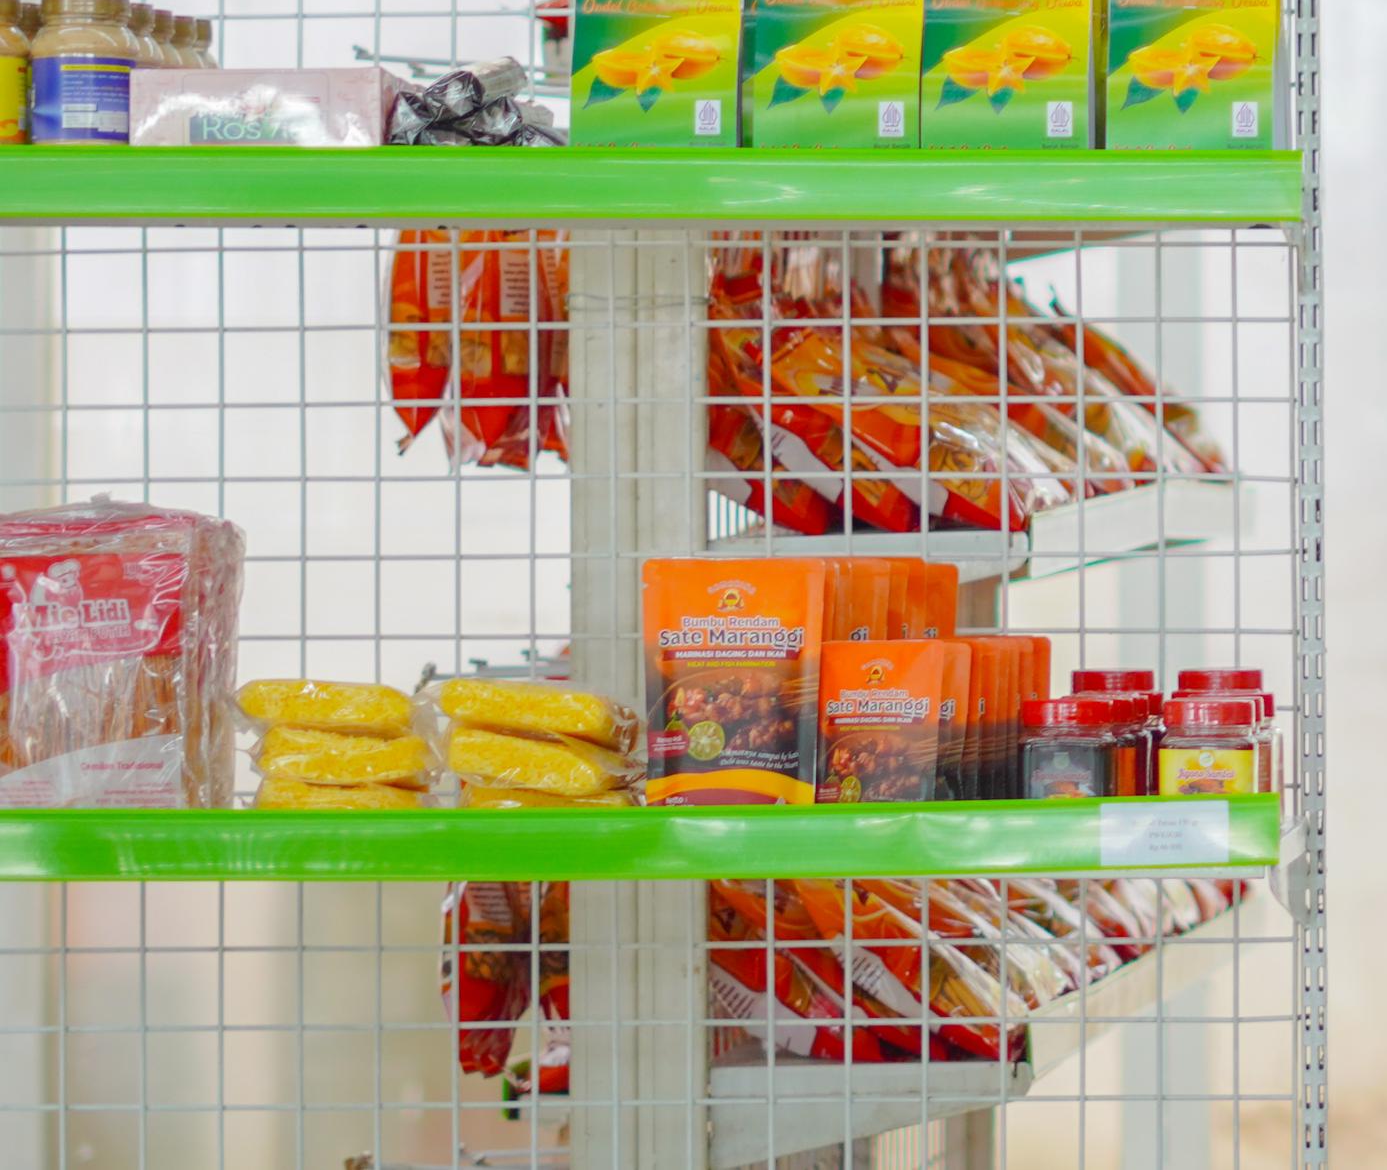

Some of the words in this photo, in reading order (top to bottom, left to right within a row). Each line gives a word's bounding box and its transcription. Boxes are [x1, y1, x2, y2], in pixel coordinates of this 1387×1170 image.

[80, 599, 131, 628] Lidi
[683, 616, 725, 628] Bumbu
[729, 616, 779, 628] Rendam
[660, 630, 702, 646] Sate
[709, 628, 803, 649] Maranggi
[827, 701, 853, 714] Sate
[858, 698, 929, 716] Maranggi
